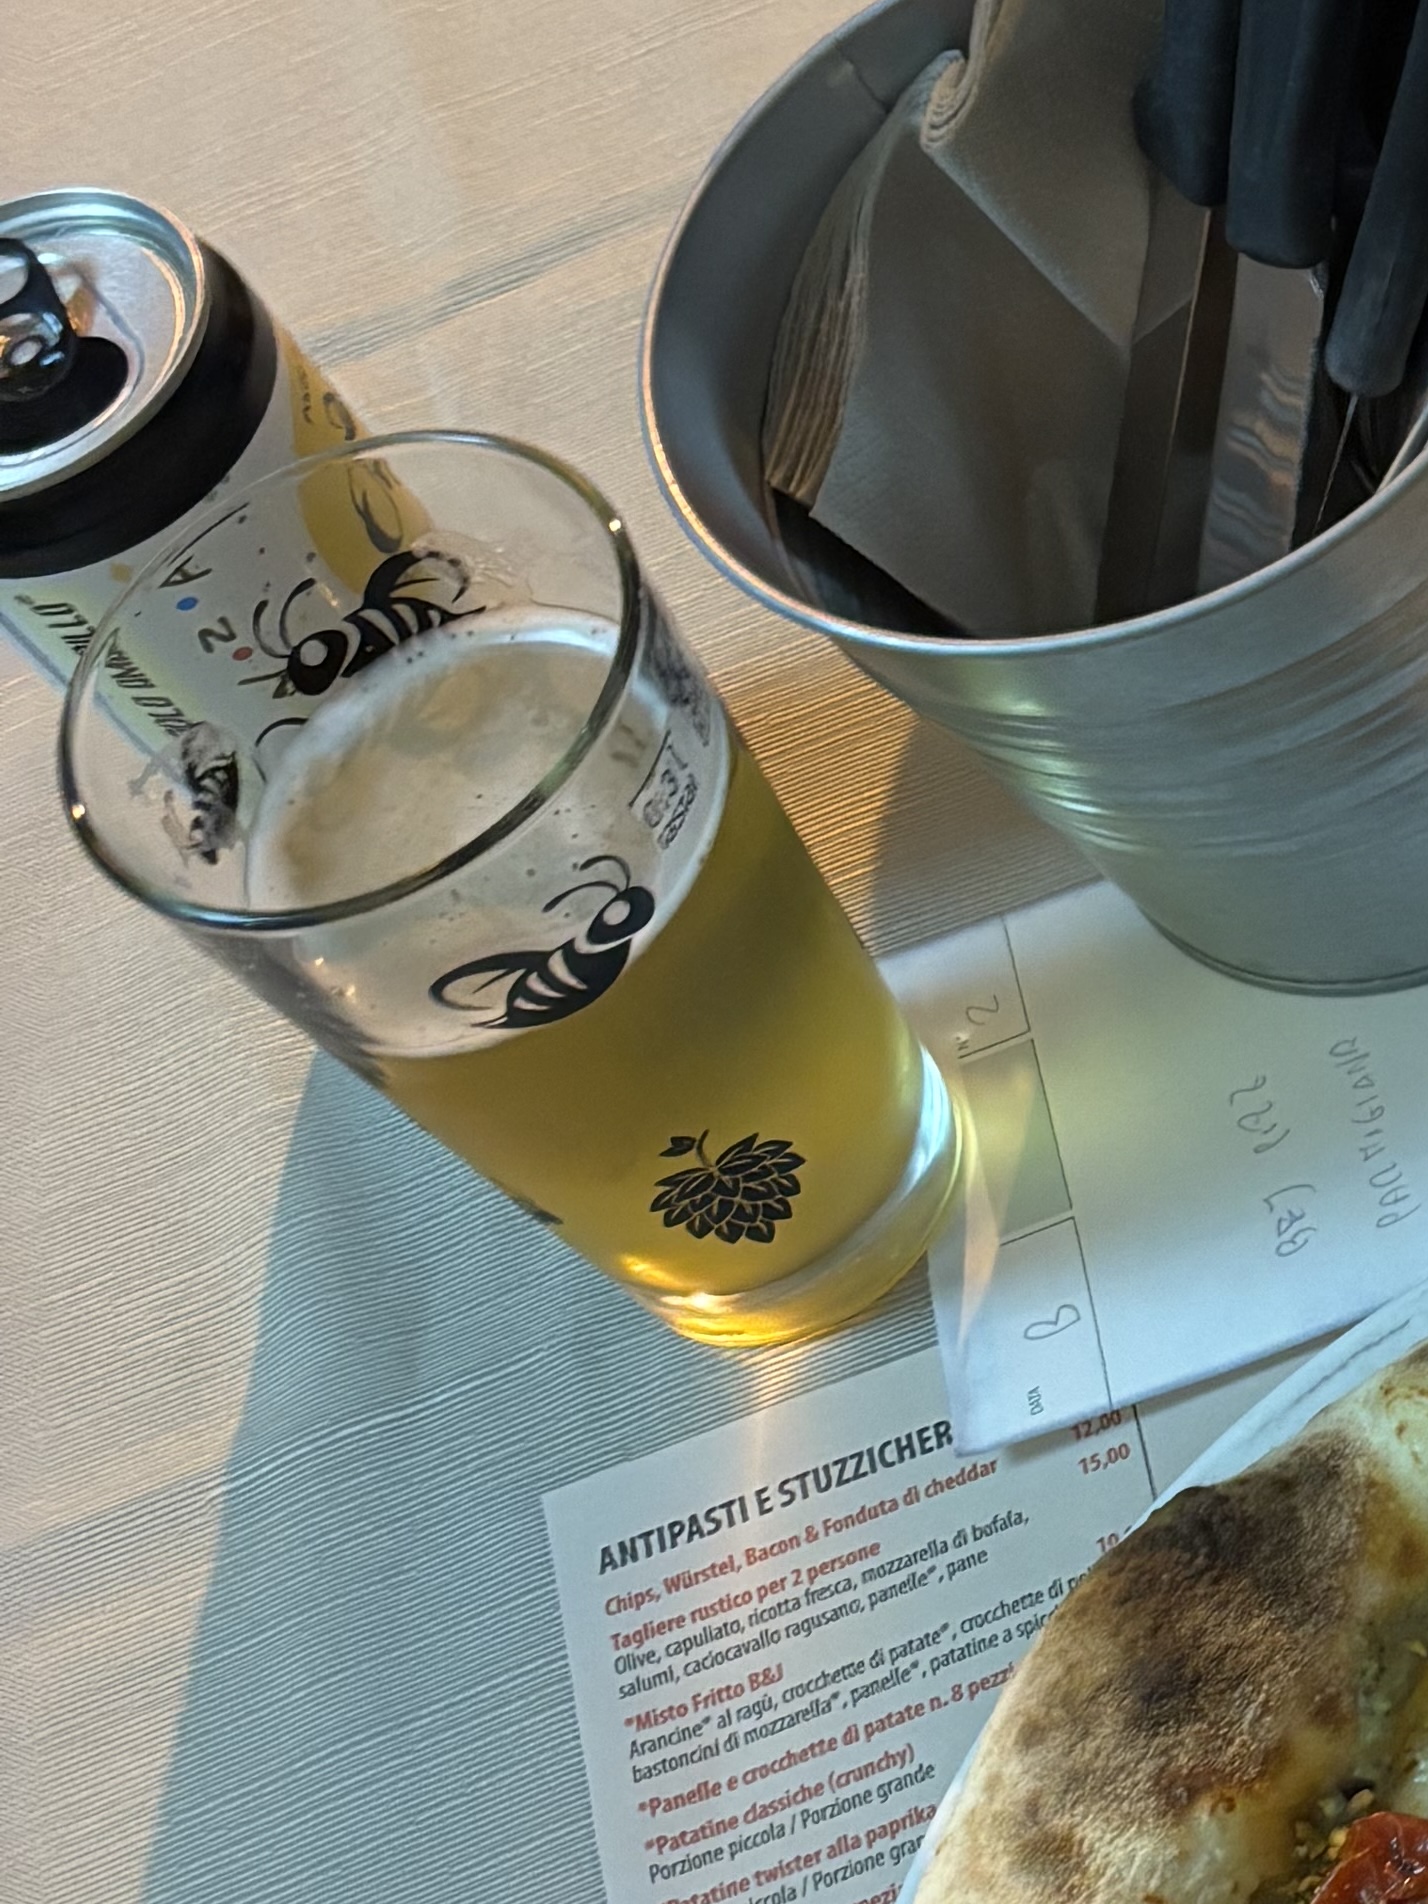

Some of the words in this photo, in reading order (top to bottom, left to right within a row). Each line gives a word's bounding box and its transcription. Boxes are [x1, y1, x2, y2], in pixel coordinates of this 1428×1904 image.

[1077, 1441, 1132, 1475] 15,00
[598, 1494, 750, 1576] ANTIPASTI
[753, 1484, 775, 1517] E
[604, 1586, 662, 1617] Chips,
[661, 1553, 743, 1595] Würstel,
[743, 1534, 802, 1567] Bacon
[803, 1523, 820, 1544] &
[821, 1496, 900, 1538] Fonduta
[901, 1484, 921, 1507] di
[923, 1458, 998, 1499] cheddar
[609, 1613, 687, 1651] Tagliere
[688, 1589, 754, 1625] rustico
[755, 1575, 788, 1605] per
[789, 1567, 804, 1588] 2
[805, 1541, 882, 1586] persone
[690, 1681, 746, 1714] Fritto
[747, 1661, 784, 1693] B&J
